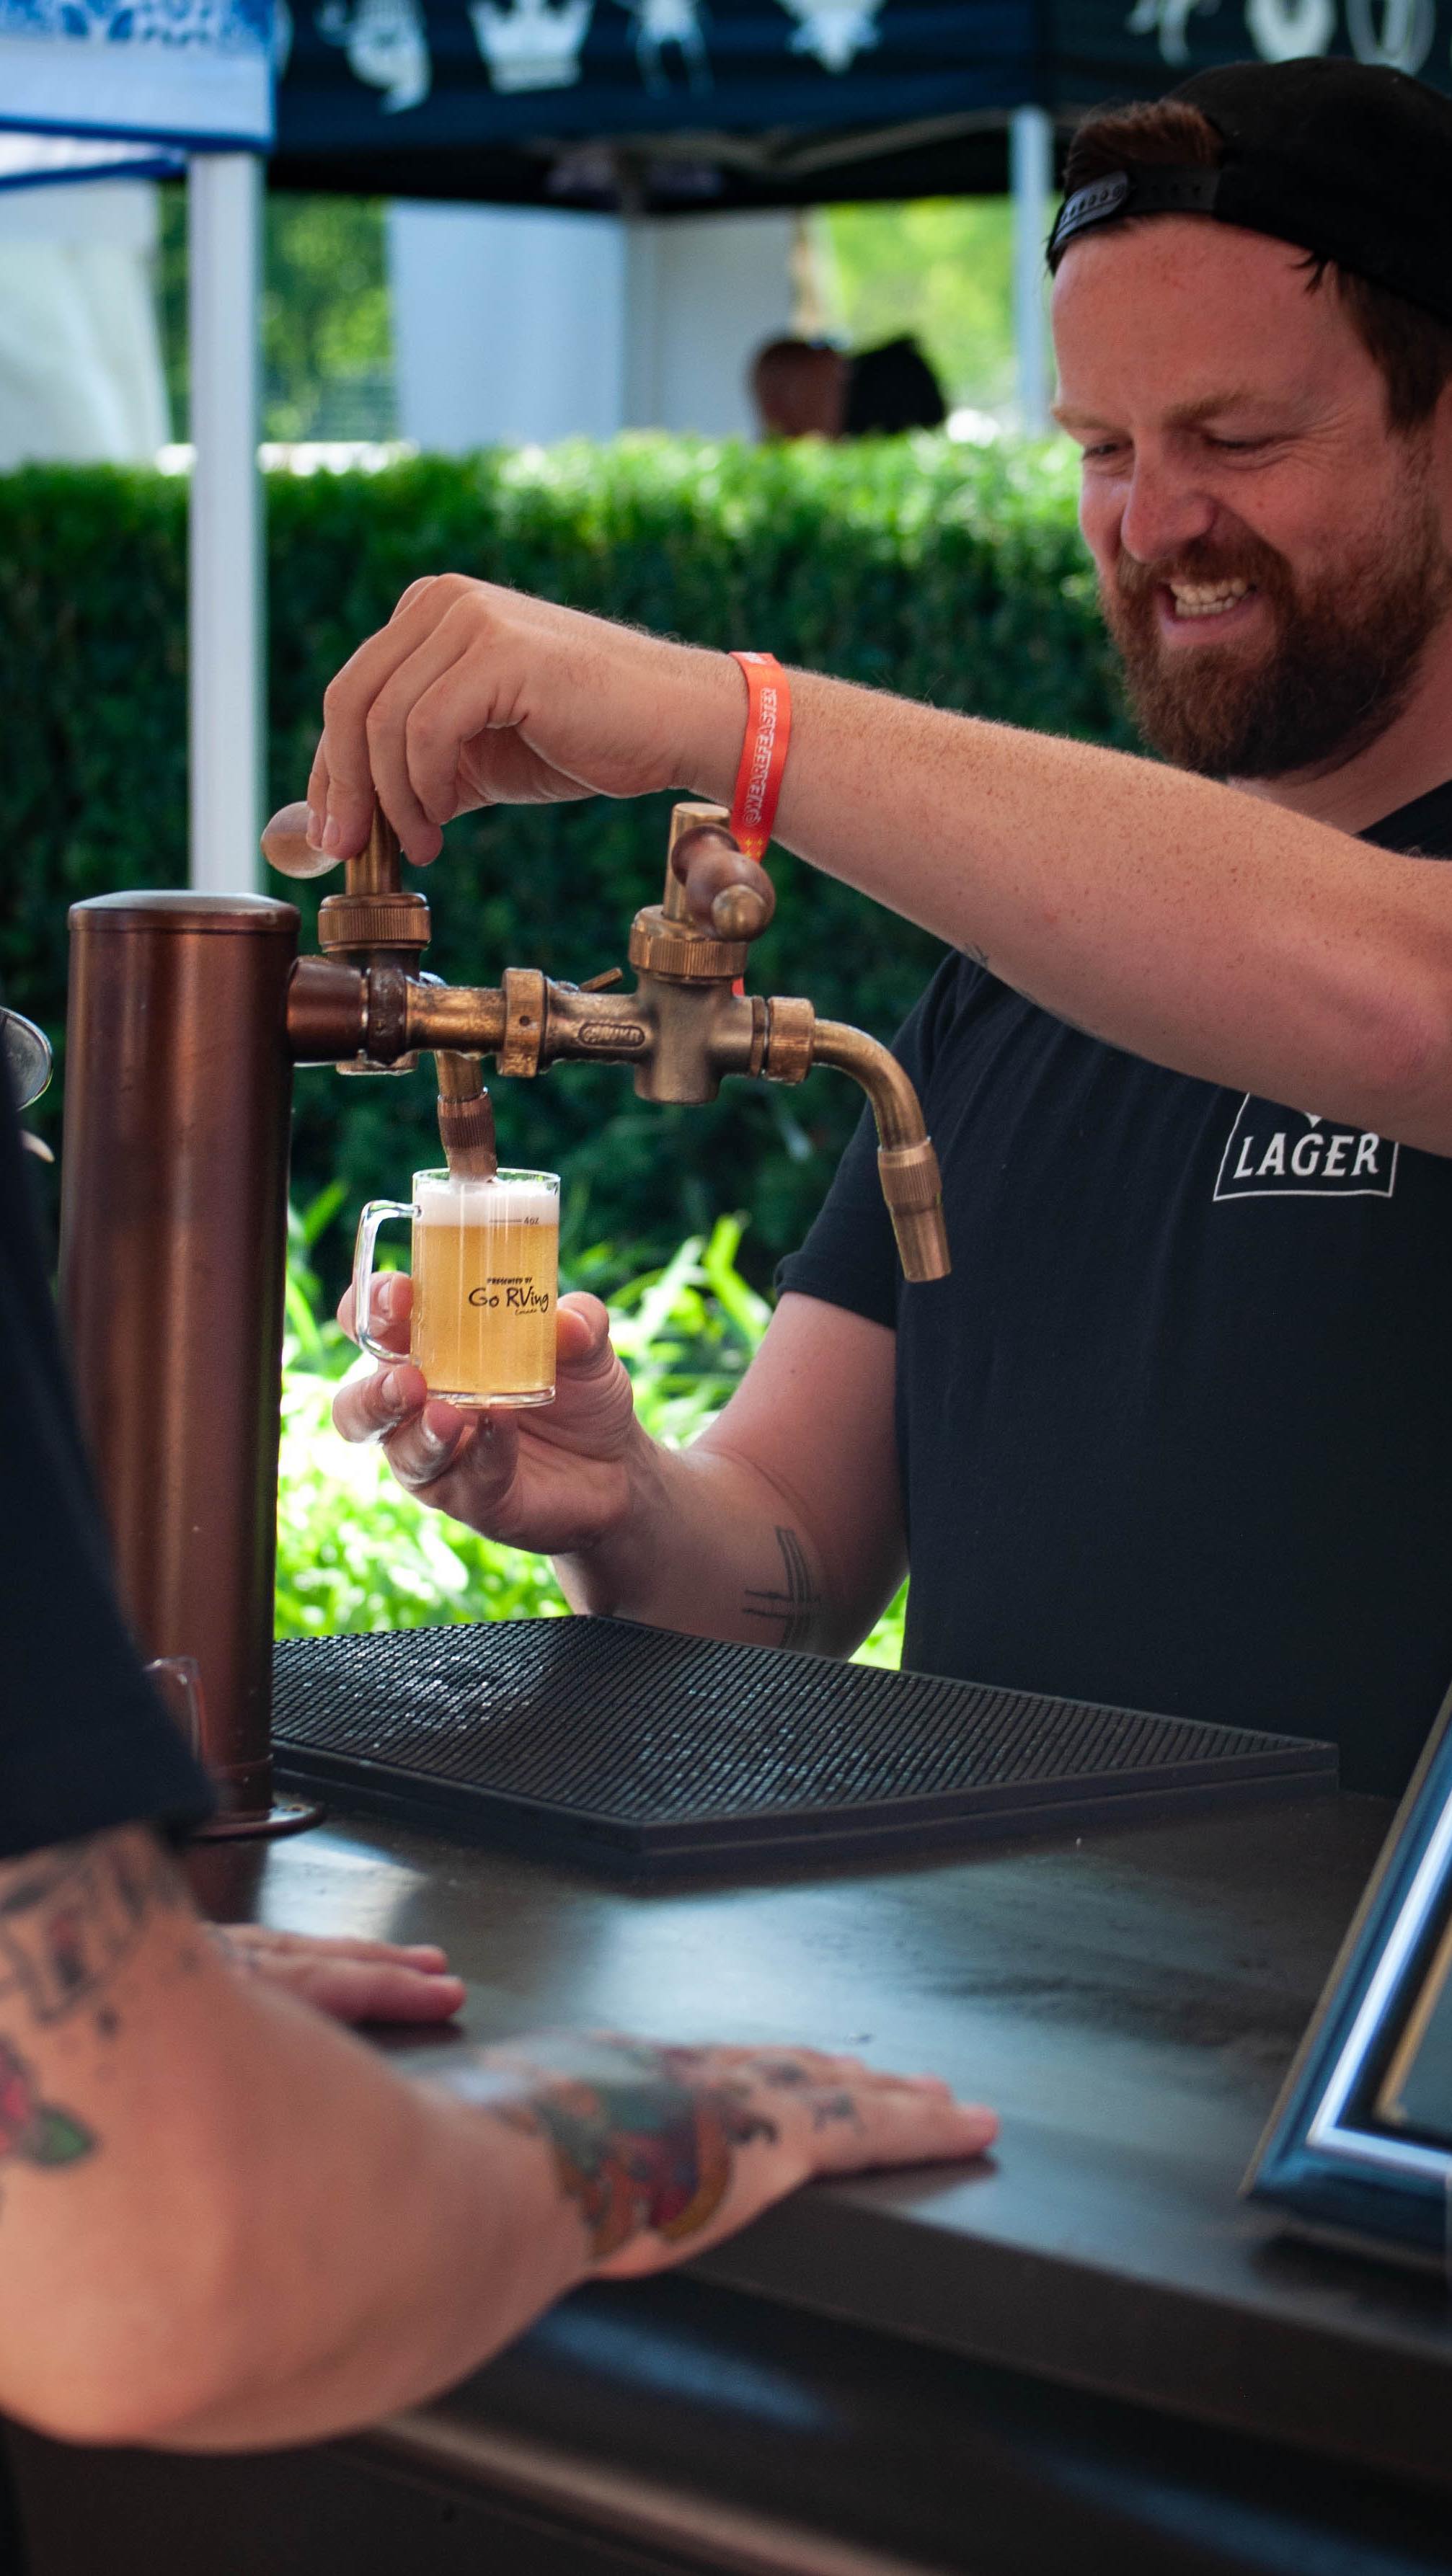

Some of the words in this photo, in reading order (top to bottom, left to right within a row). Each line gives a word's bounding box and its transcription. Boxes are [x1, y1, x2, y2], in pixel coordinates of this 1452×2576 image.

[1234, 1132, 1380, 1178] LAGER
[469, 1287, 500, 1307] Go
[506, 1286, 549, 1313] RVing
